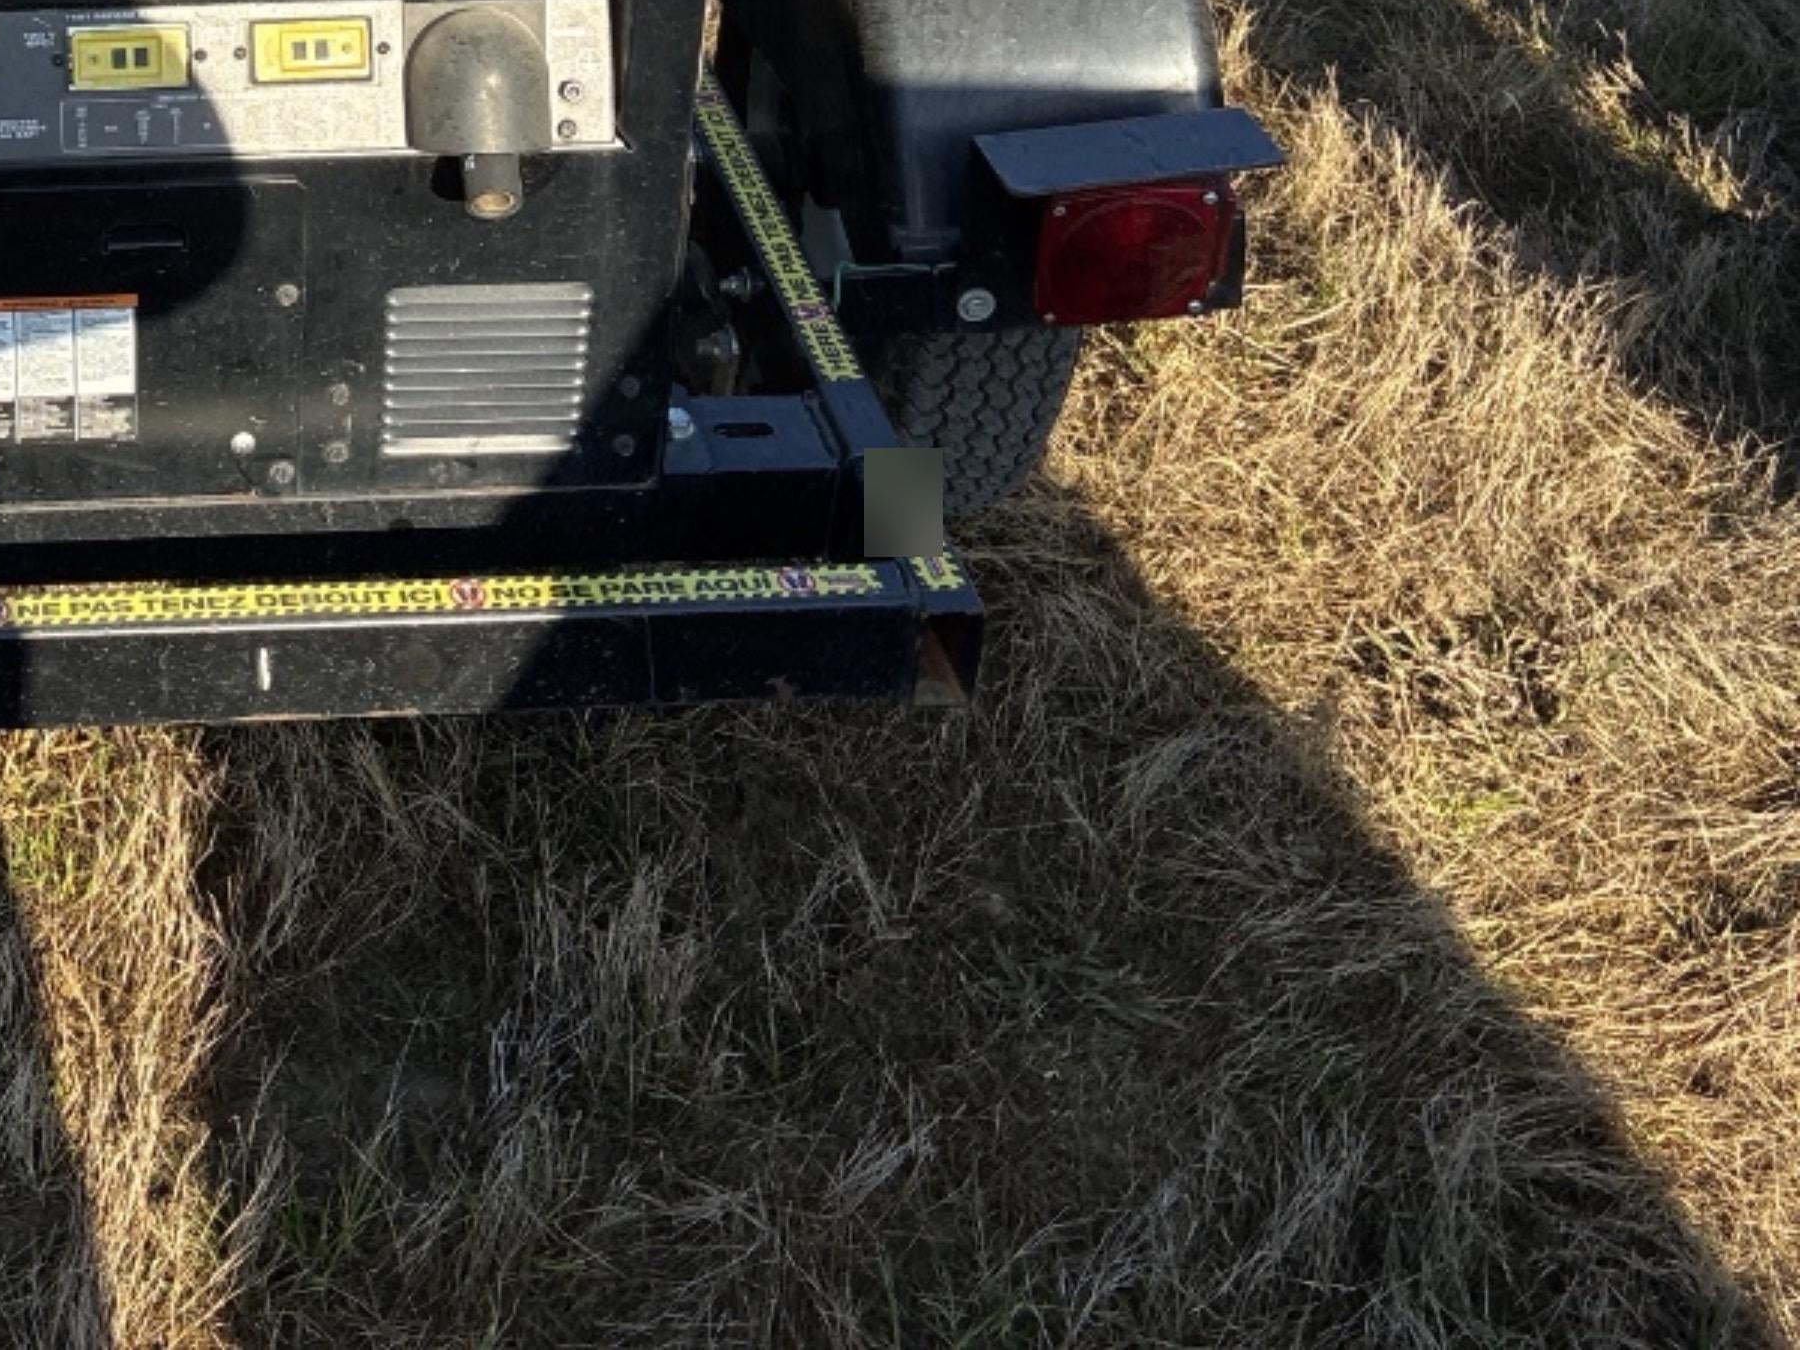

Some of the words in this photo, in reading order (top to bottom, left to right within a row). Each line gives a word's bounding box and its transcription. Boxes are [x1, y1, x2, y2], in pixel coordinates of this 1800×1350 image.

[17, 601, 61, 619] NE
[69, 598, 134, 617] PAS
[140, 595, 247, 613] TENEZ
[255, 589, 392, 608] DEBOUT
[399, 586, 443, 604] ICI
[491, 585, 542, 600] NO
[549, 583, 594, 599] SE
[598, 580, 686, 596] PARE
